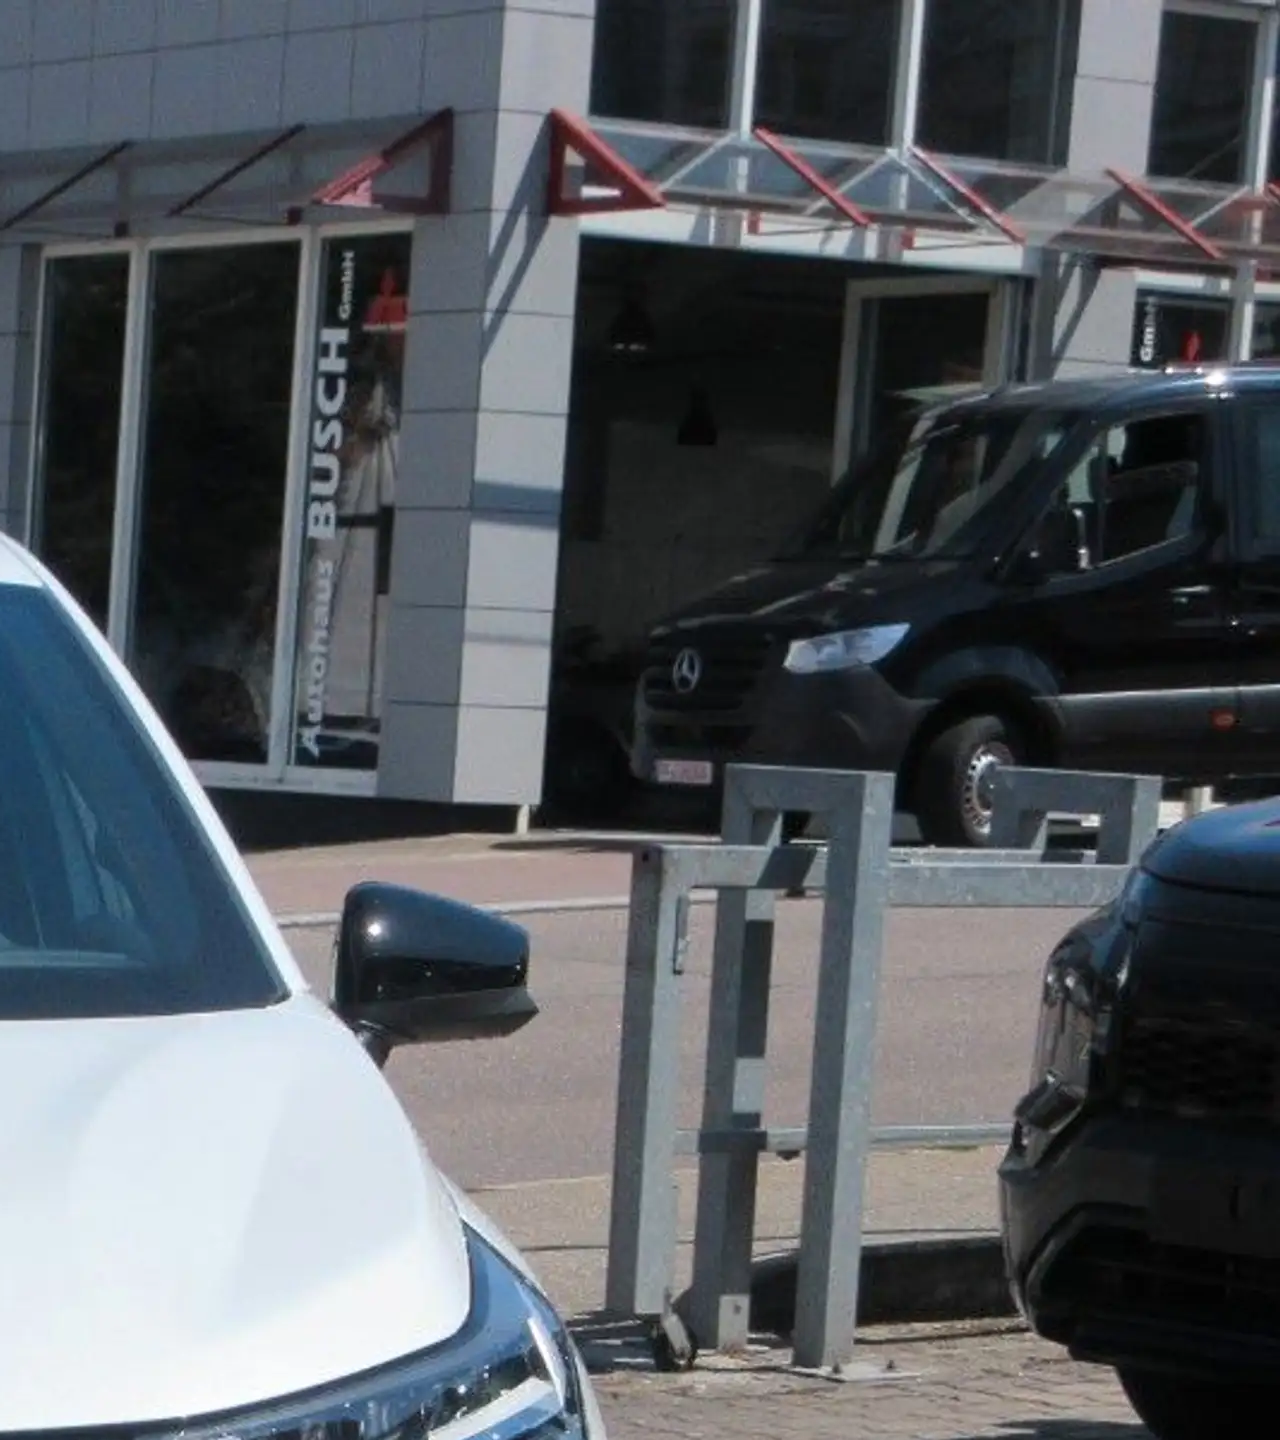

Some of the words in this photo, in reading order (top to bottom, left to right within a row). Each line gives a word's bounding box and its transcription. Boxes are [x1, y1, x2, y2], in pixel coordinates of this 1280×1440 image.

[338, 250, 355, 320] GmbH
[306, 328, 349, 539] BUSCH
[302, 559, 334, 757] Autohaus
